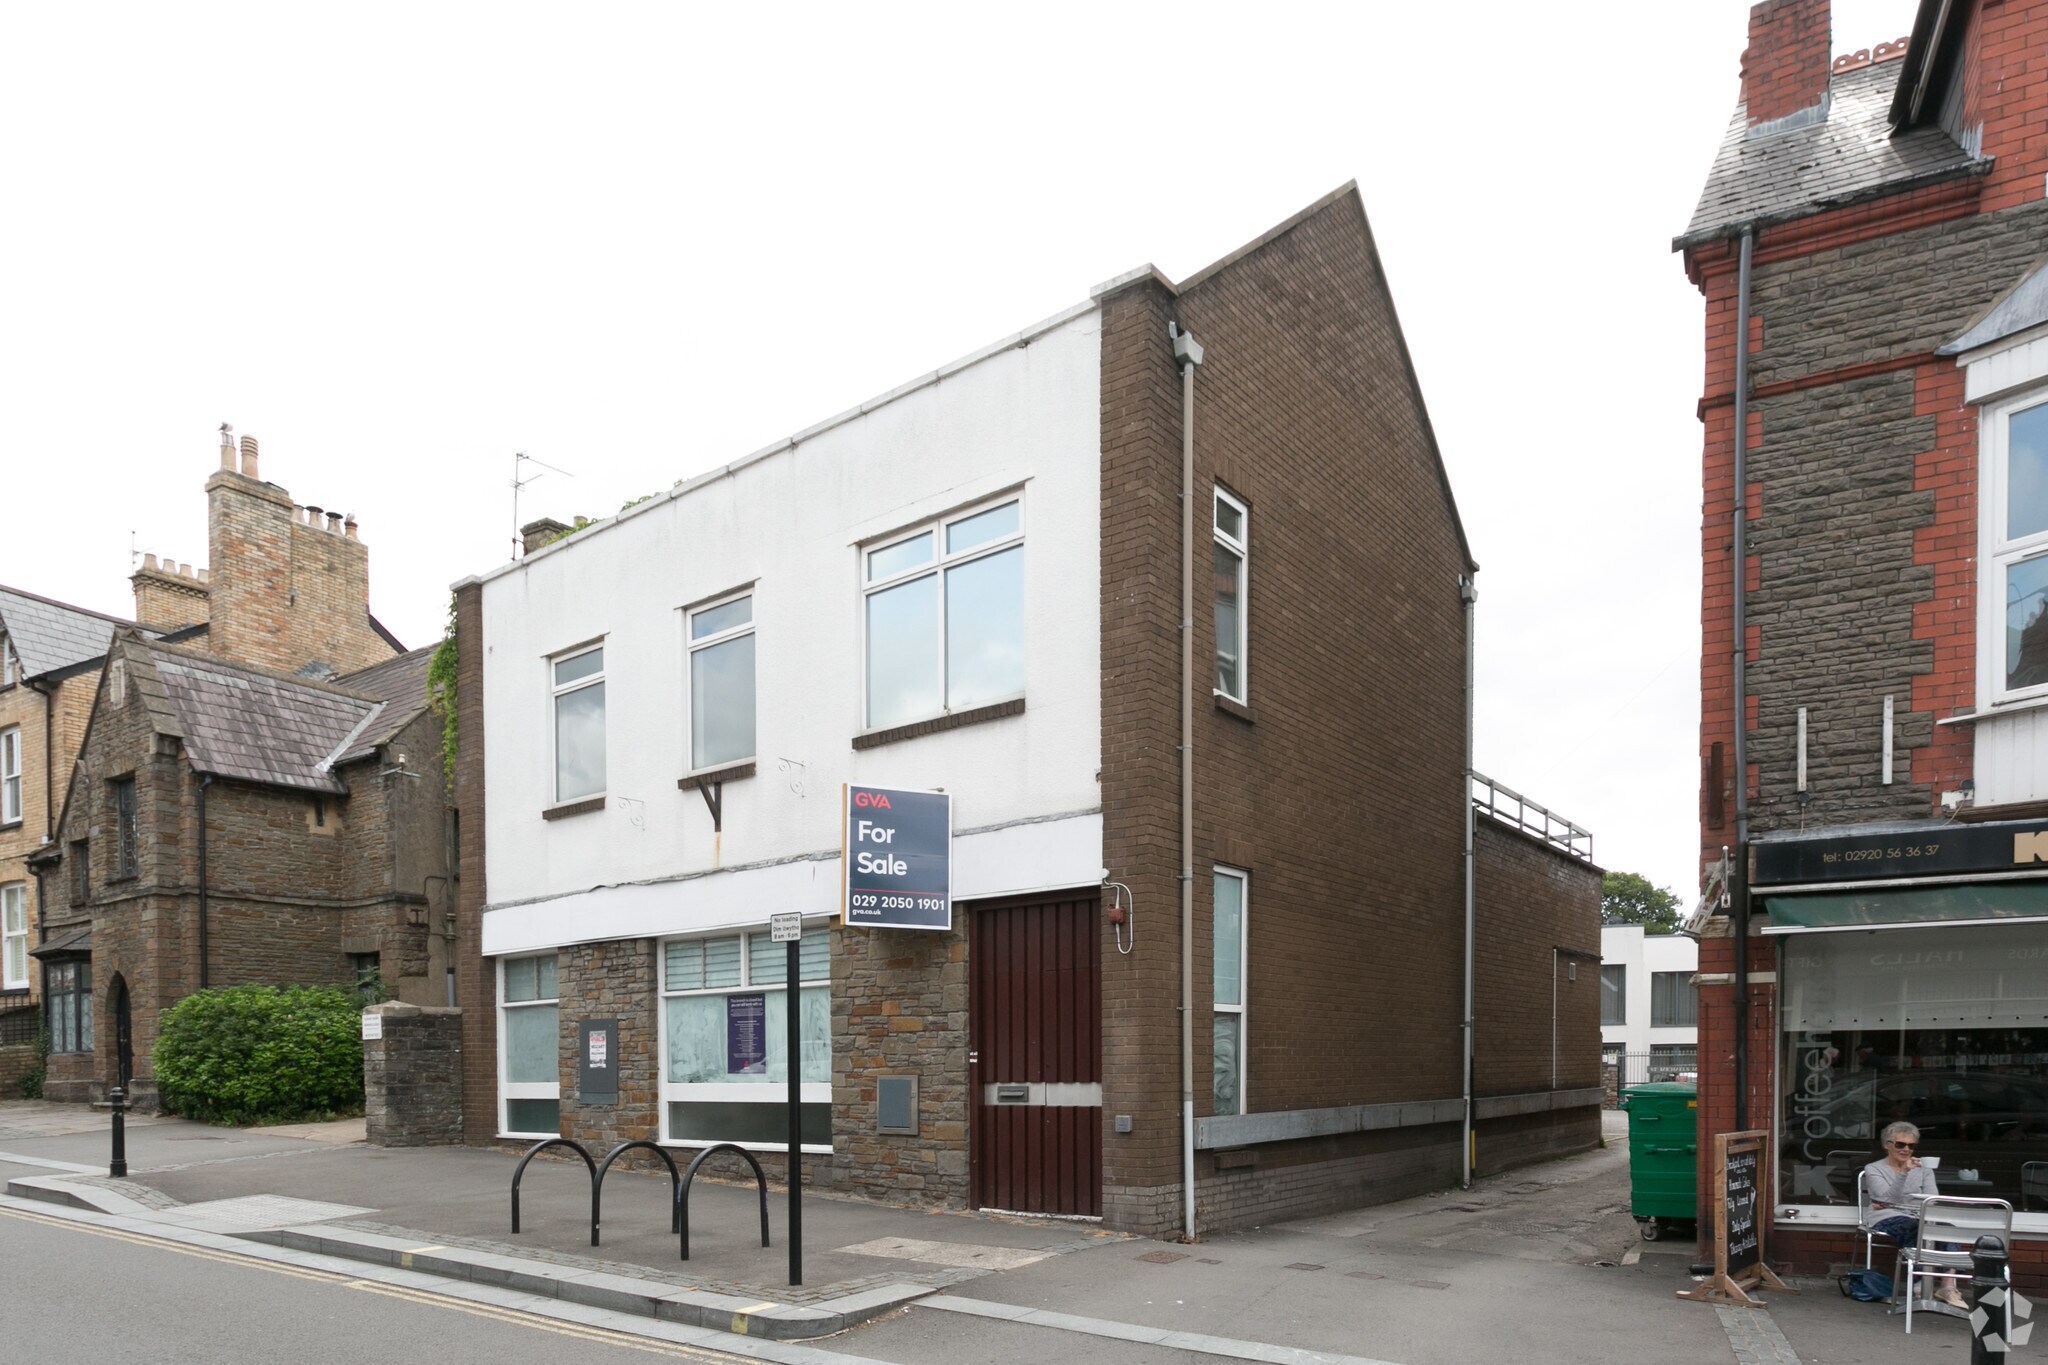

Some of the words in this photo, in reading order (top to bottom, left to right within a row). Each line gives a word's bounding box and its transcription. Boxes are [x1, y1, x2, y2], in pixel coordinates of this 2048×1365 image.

[854, 792, 891, 809] GVA
[858, 820, 896, 844] For
[1823, 851, 1842, 863] tel:
[1844, 847, 1882, 862] 02920
[1886, 847, 1902, 859] 56
[1905, 846, 1921, 858] 36
[1924, 844, 1940, 856] 37
[856, 852, 908, 876] Sale
[852, 894, 877, 907] 029
[881, 896, 914, 909] 2050
[917, 898, 945, 911] 1901
